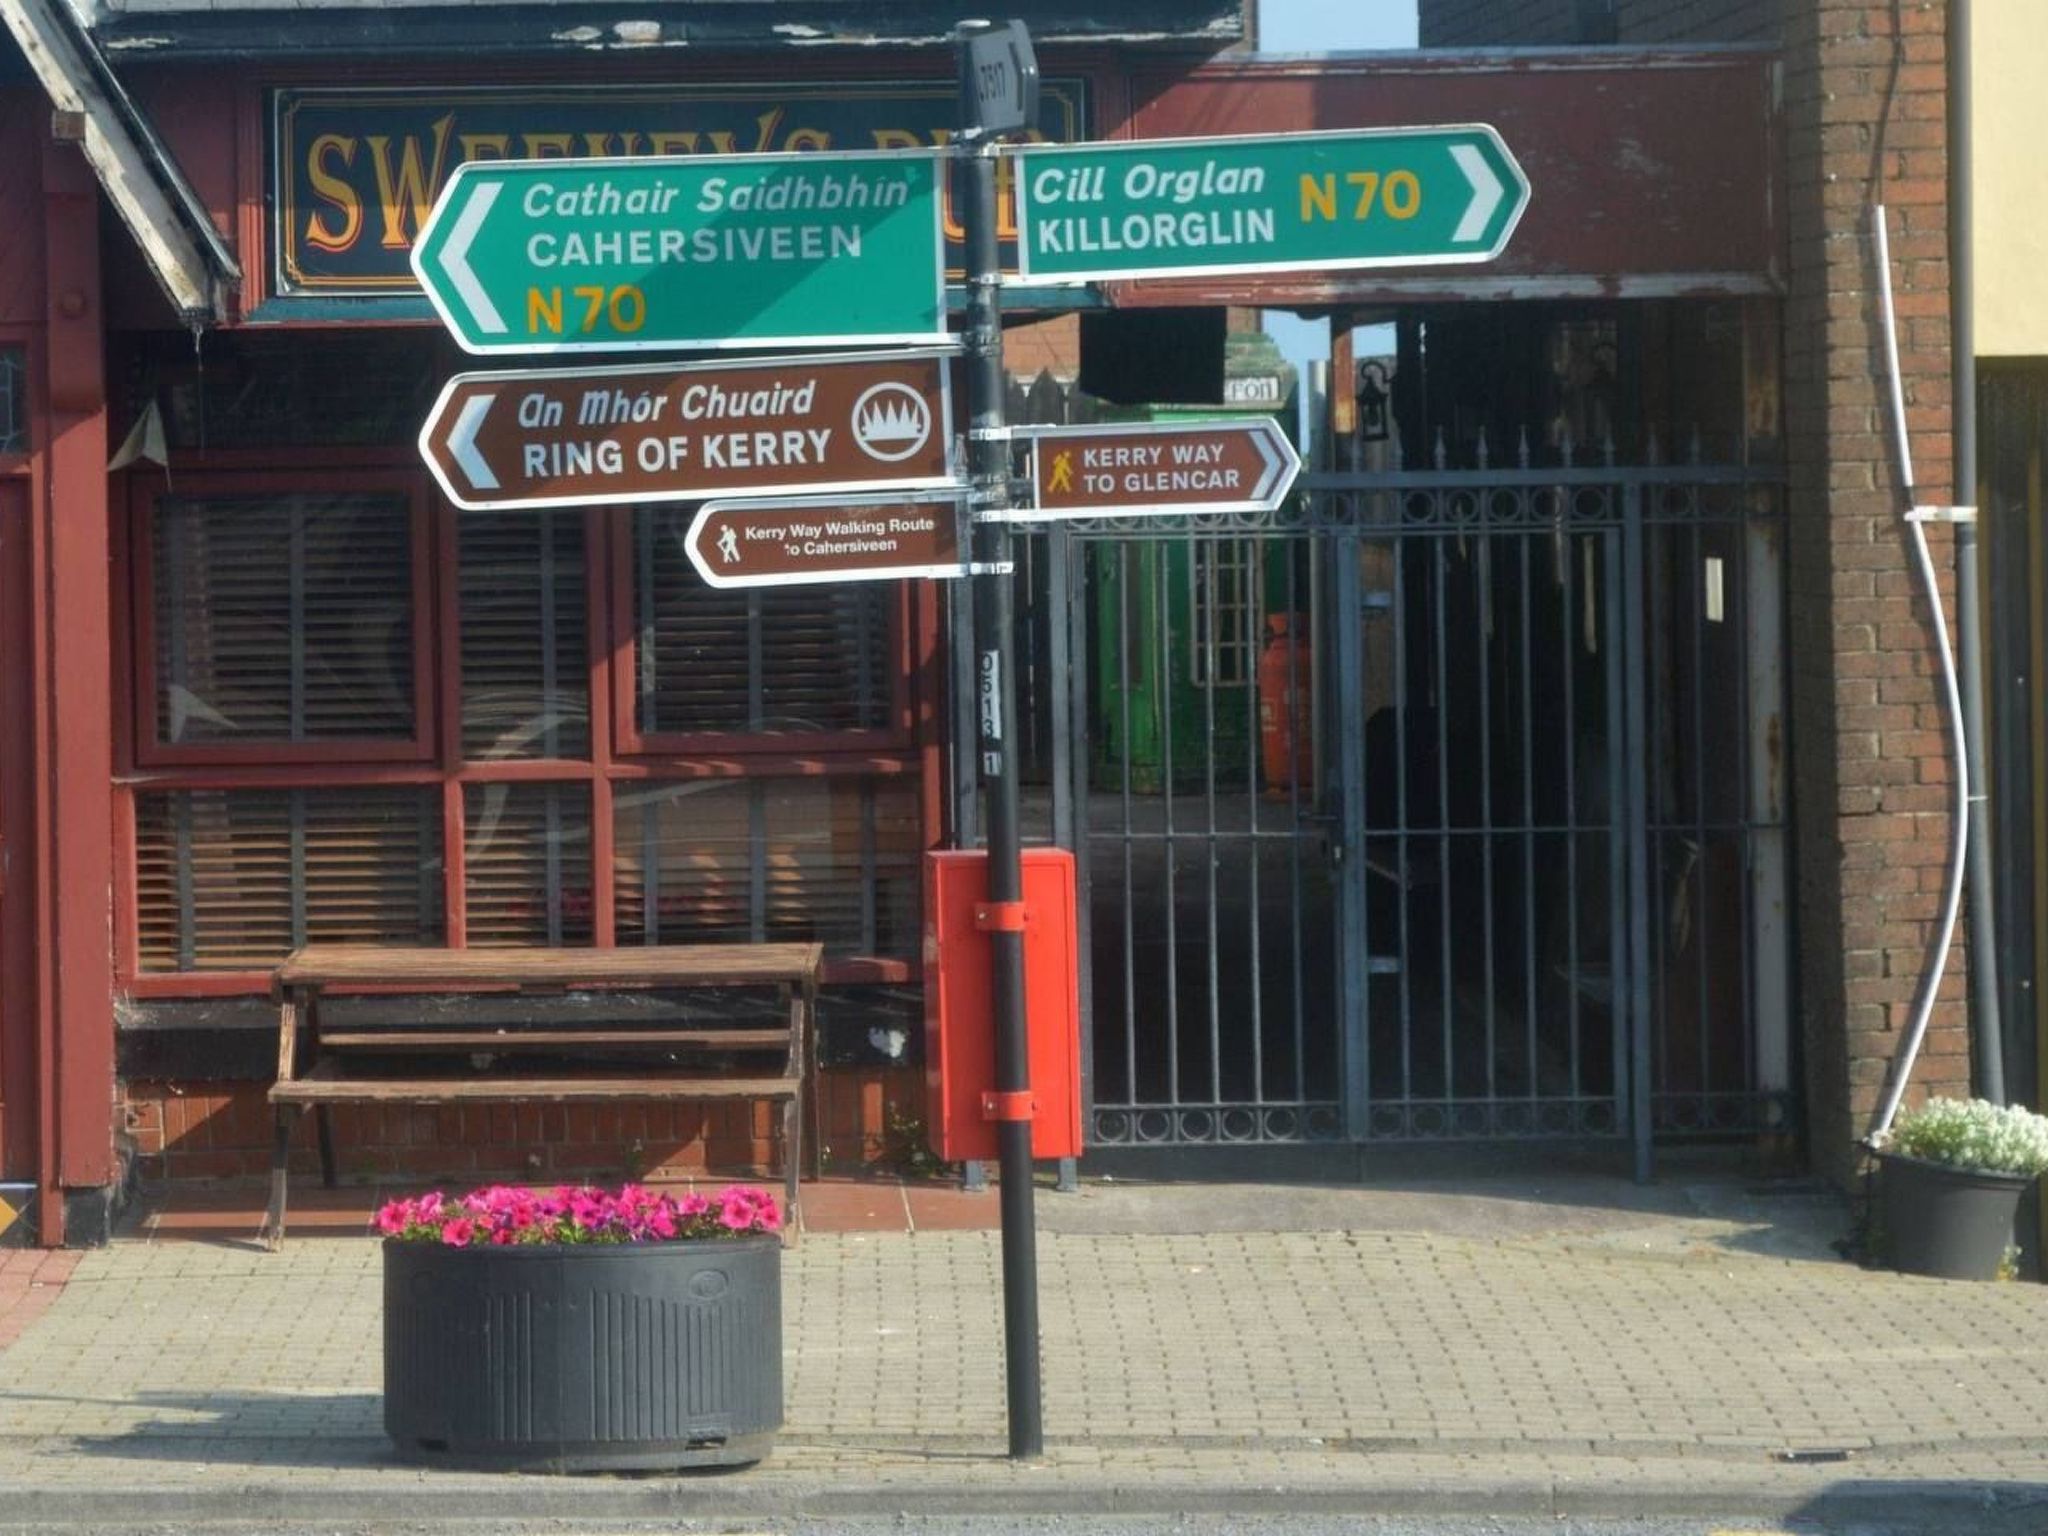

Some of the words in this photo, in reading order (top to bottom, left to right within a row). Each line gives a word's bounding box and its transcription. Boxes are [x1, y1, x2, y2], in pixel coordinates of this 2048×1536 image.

[523, 181, 680, 217] Cathair
[1033, 165, 1105, 204] Cill
[1124, 161, 1266, 203] Orglan
[527, 224, 862, 267] CAHERSIVEEN
[1038, 207, 1275, 254] KILLORGLIN
[578, 389, 668, 426] Mhór
[681, 380, 817, 421] Chuaird
[523, 439, 623, 478] RING
[637, 435, 689, 473] OF
[703, 429, 832, 469] KERRY
[1083, 447, 1162, 468] KERRY
[1171, 443, 1224, 465] WAY
[1083, 474, 1116, 494] TO
[1124, 469, 1240, 492] GLENCAR
[745, 526, 787, 541] Kerry
[790, 523, 822, 538] Way
[825, 519, 885, 535] Walking
[889, 517, 935, 532] Route
[804, 539, 898, 555] Cahersiveen
